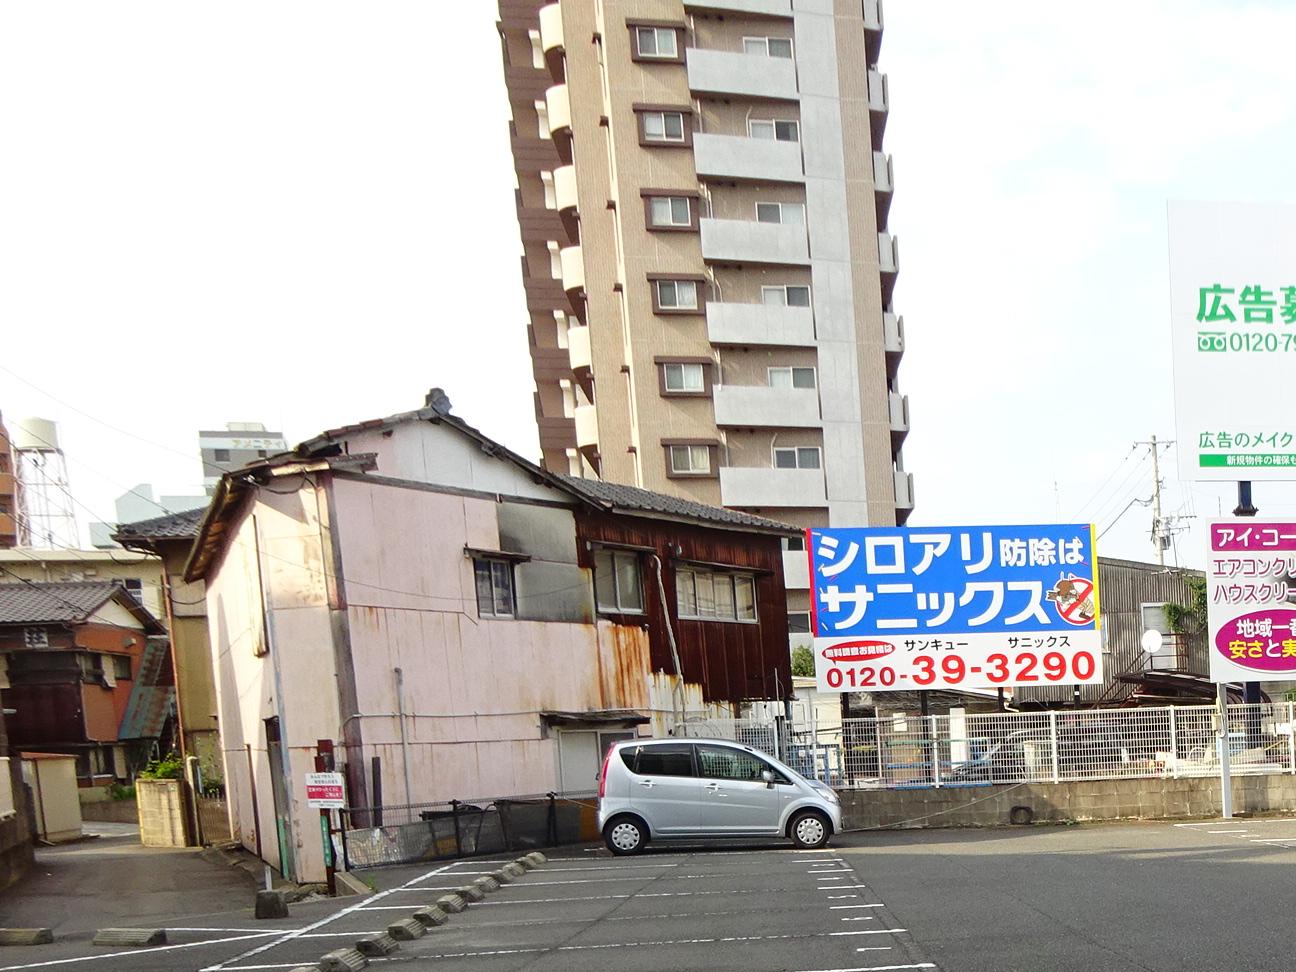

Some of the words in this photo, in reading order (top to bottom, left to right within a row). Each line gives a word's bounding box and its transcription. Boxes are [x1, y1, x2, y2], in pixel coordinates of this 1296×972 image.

[1199, 431, 1293, 450] 広告のメイク
[820, 580, 1052, 630] サニックス
[904, 638, 969, 652] サンキュー
[1007, 635, 1071, 649] サニックス
[826, 651, 1096, 688] 0120-39-3290
